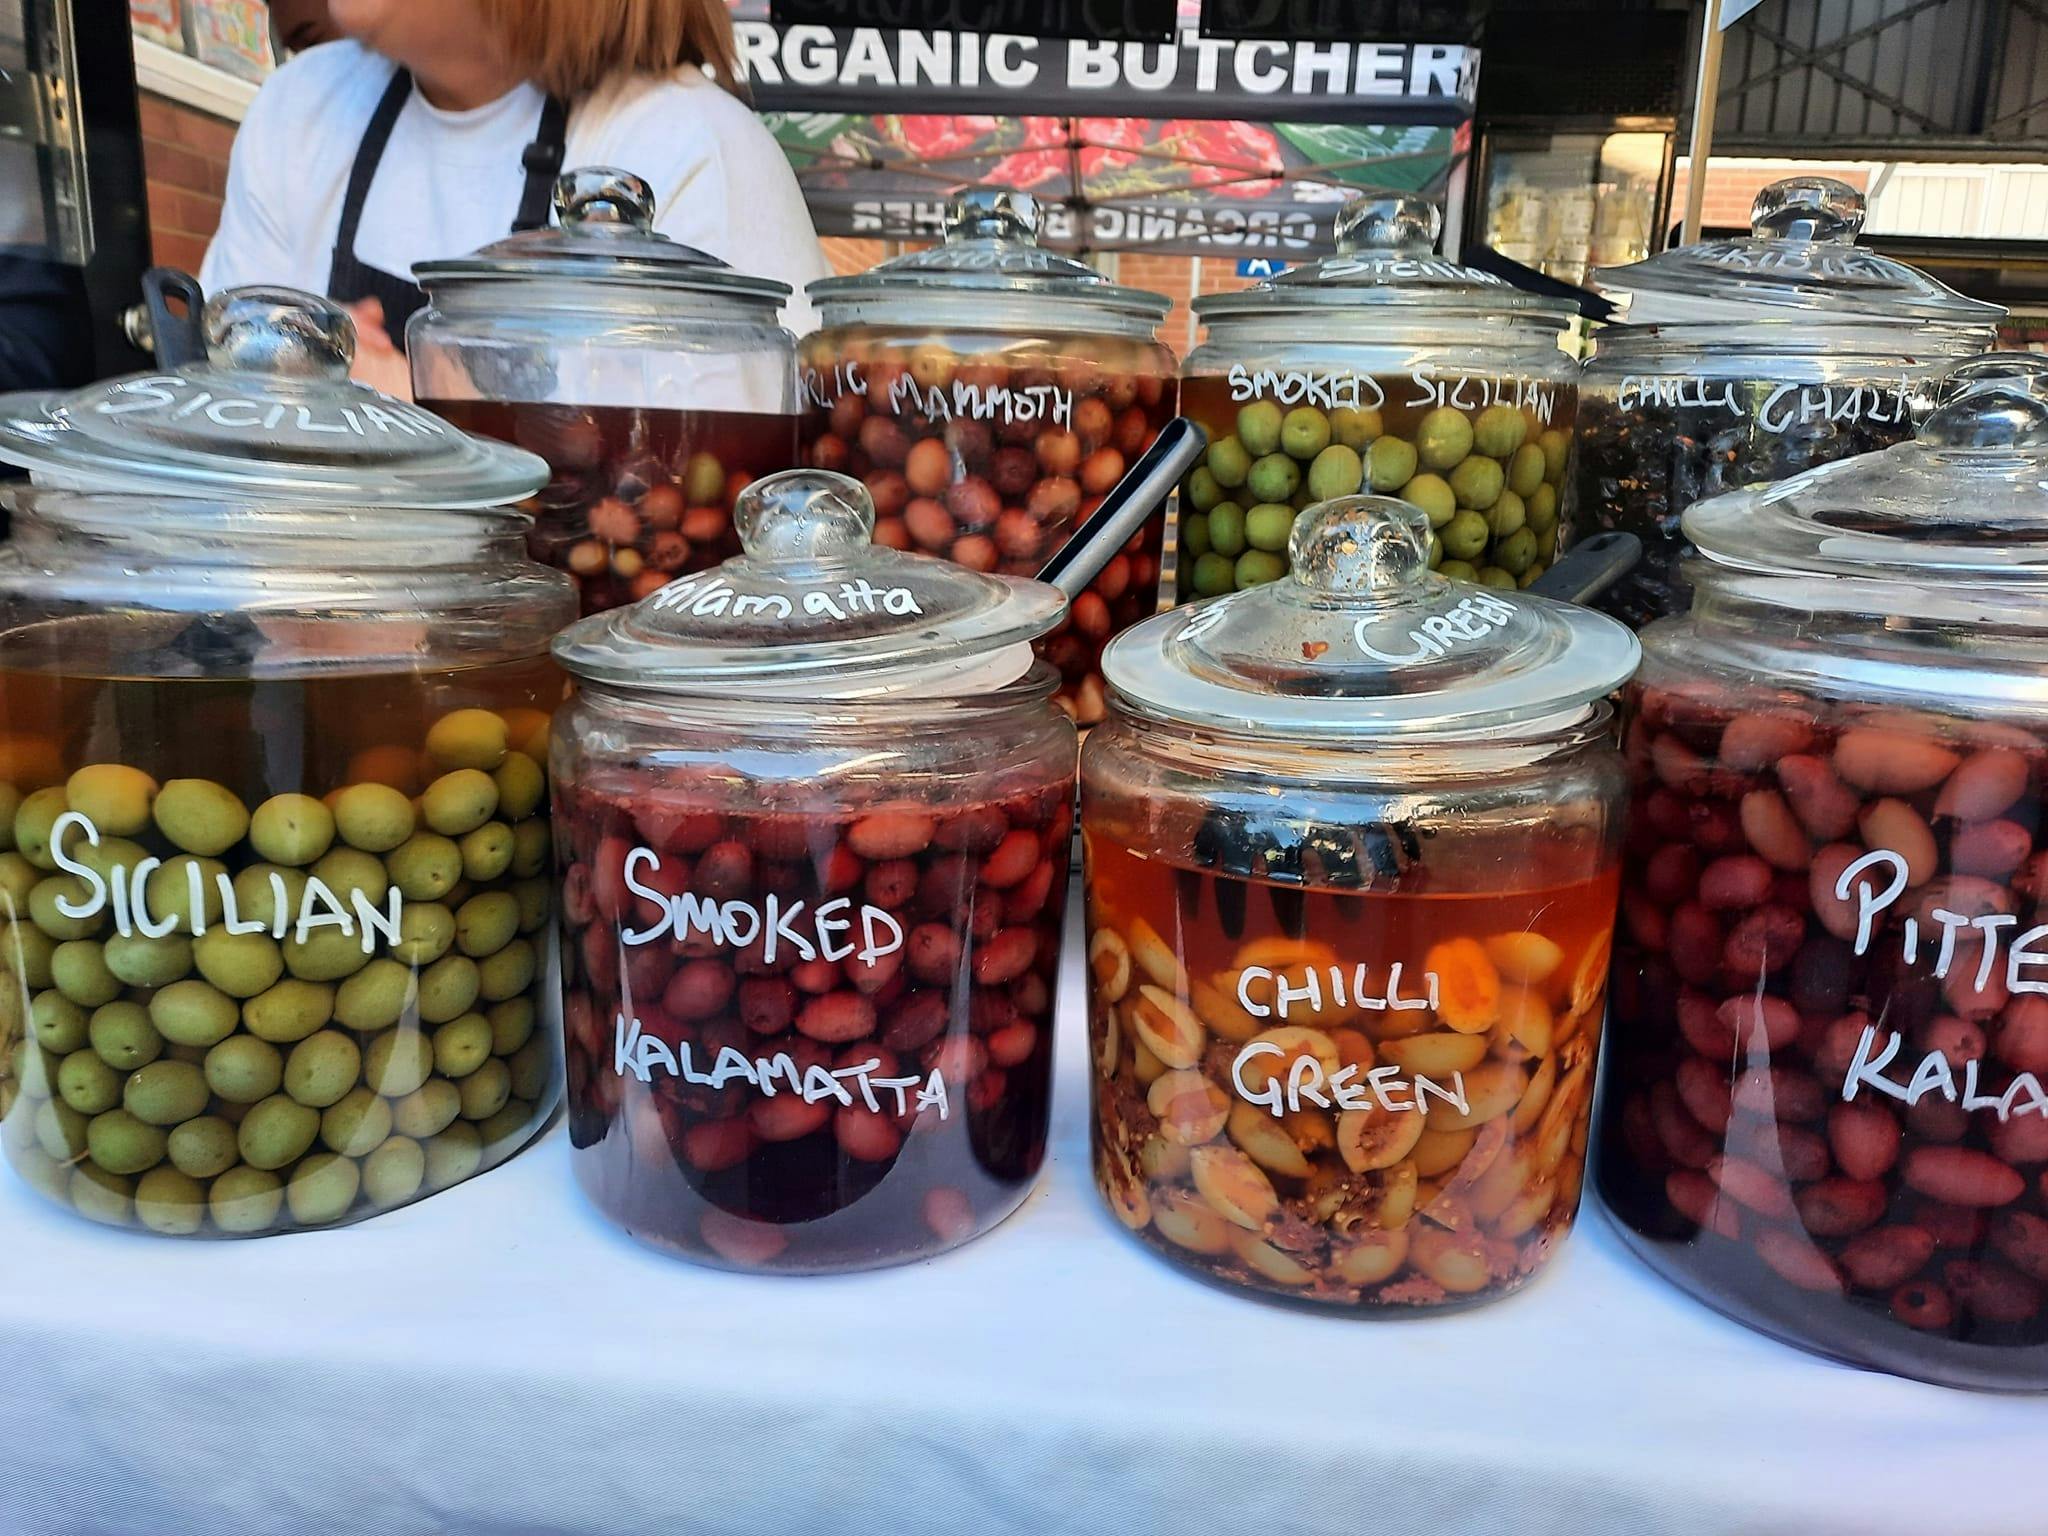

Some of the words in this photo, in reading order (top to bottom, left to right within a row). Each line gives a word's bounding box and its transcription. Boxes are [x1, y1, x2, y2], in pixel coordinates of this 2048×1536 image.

[701, 21, 1039, 87] RGANIC
[1067, 29, 1460, 97] BUTCHER
[96, 375, 445, 436] SICILIAN
[889, 372, 1072, 432] MAMMOTH
[1227, 363, 1385, 413] SMOKED
[1406, 362, 1554, 426] SICILIAN
[1618, 374, 1745, 417] CHILLI
[1353, 591, 1518, 664] GREEN
[50, 811, 402, 953] SICILIAN
[622, 847, 904, 967] SMOKED
[1237, 962, 1440, 1018] CHILLI
[615, 1012, 949, 1120] KALAMATTA
[1232, 1042, 1470, 1117] GREEN
